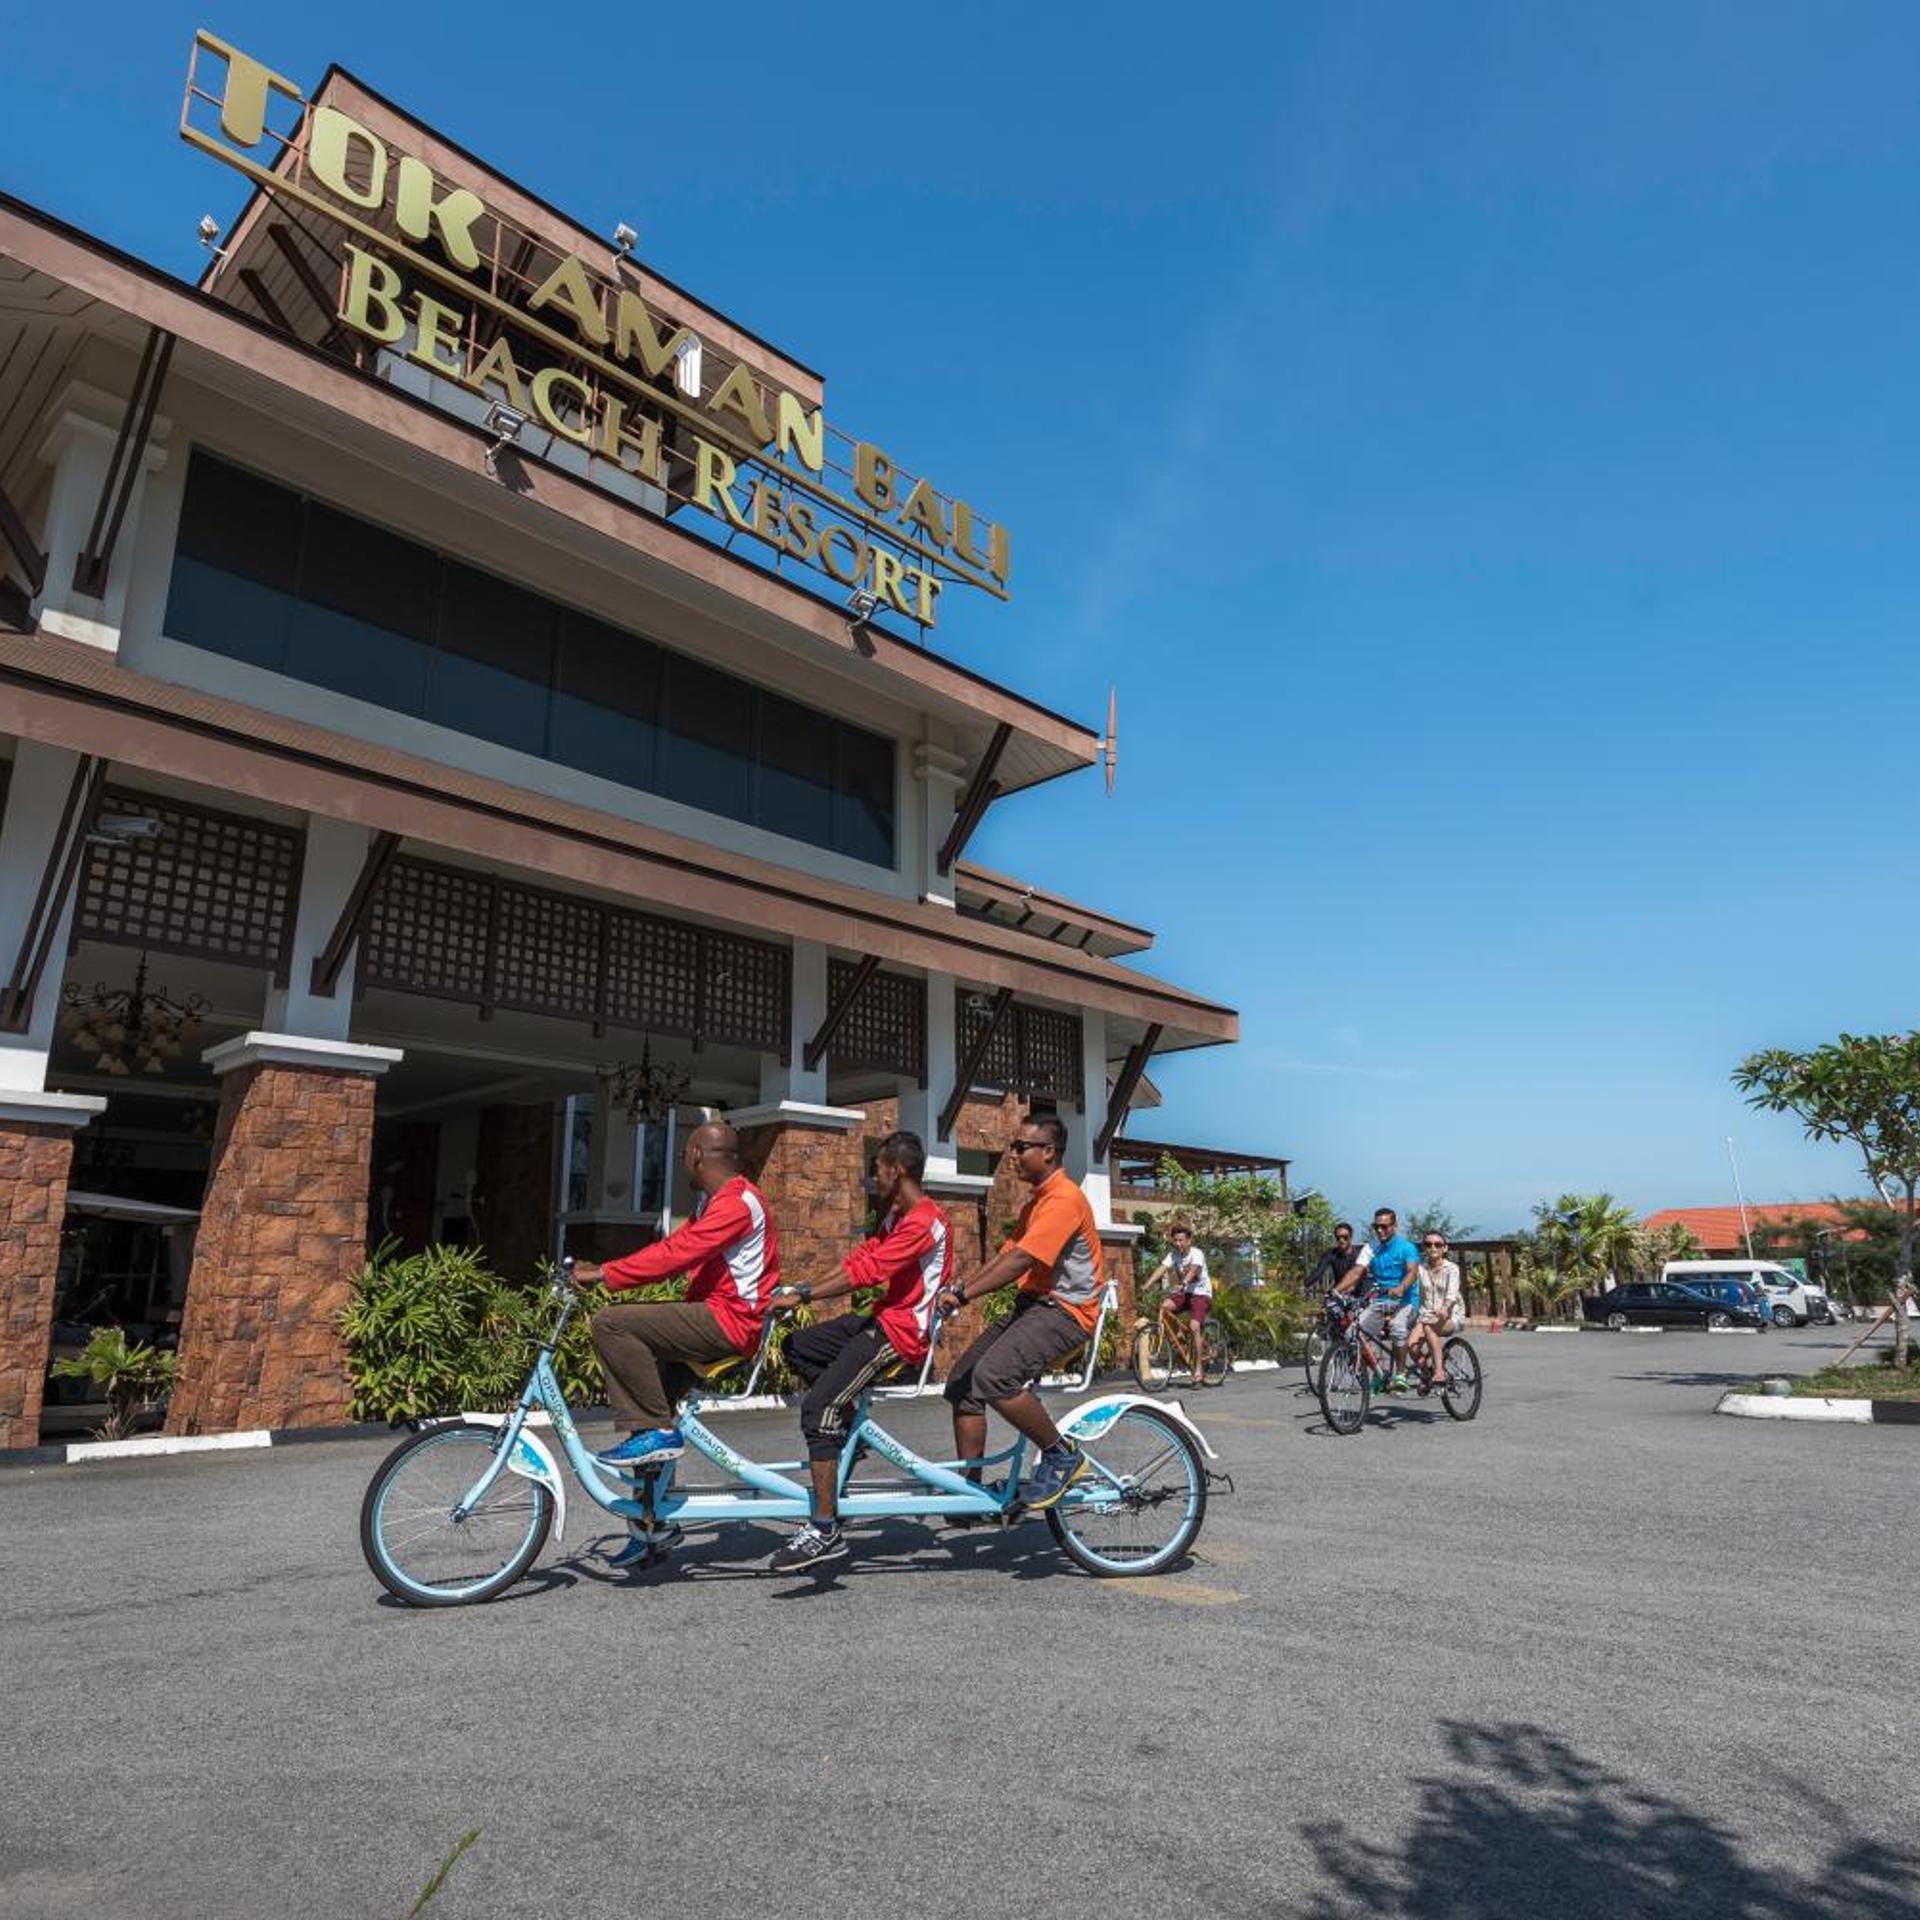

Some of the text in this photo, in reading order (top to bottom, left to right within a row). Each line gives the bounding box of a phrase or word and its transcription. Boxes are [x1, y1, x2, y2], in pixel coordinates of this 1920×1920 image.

[196, 28, 1009, 584] TOK AMAN BALI
[337, 241, 943, 629] BEACH RESORT
